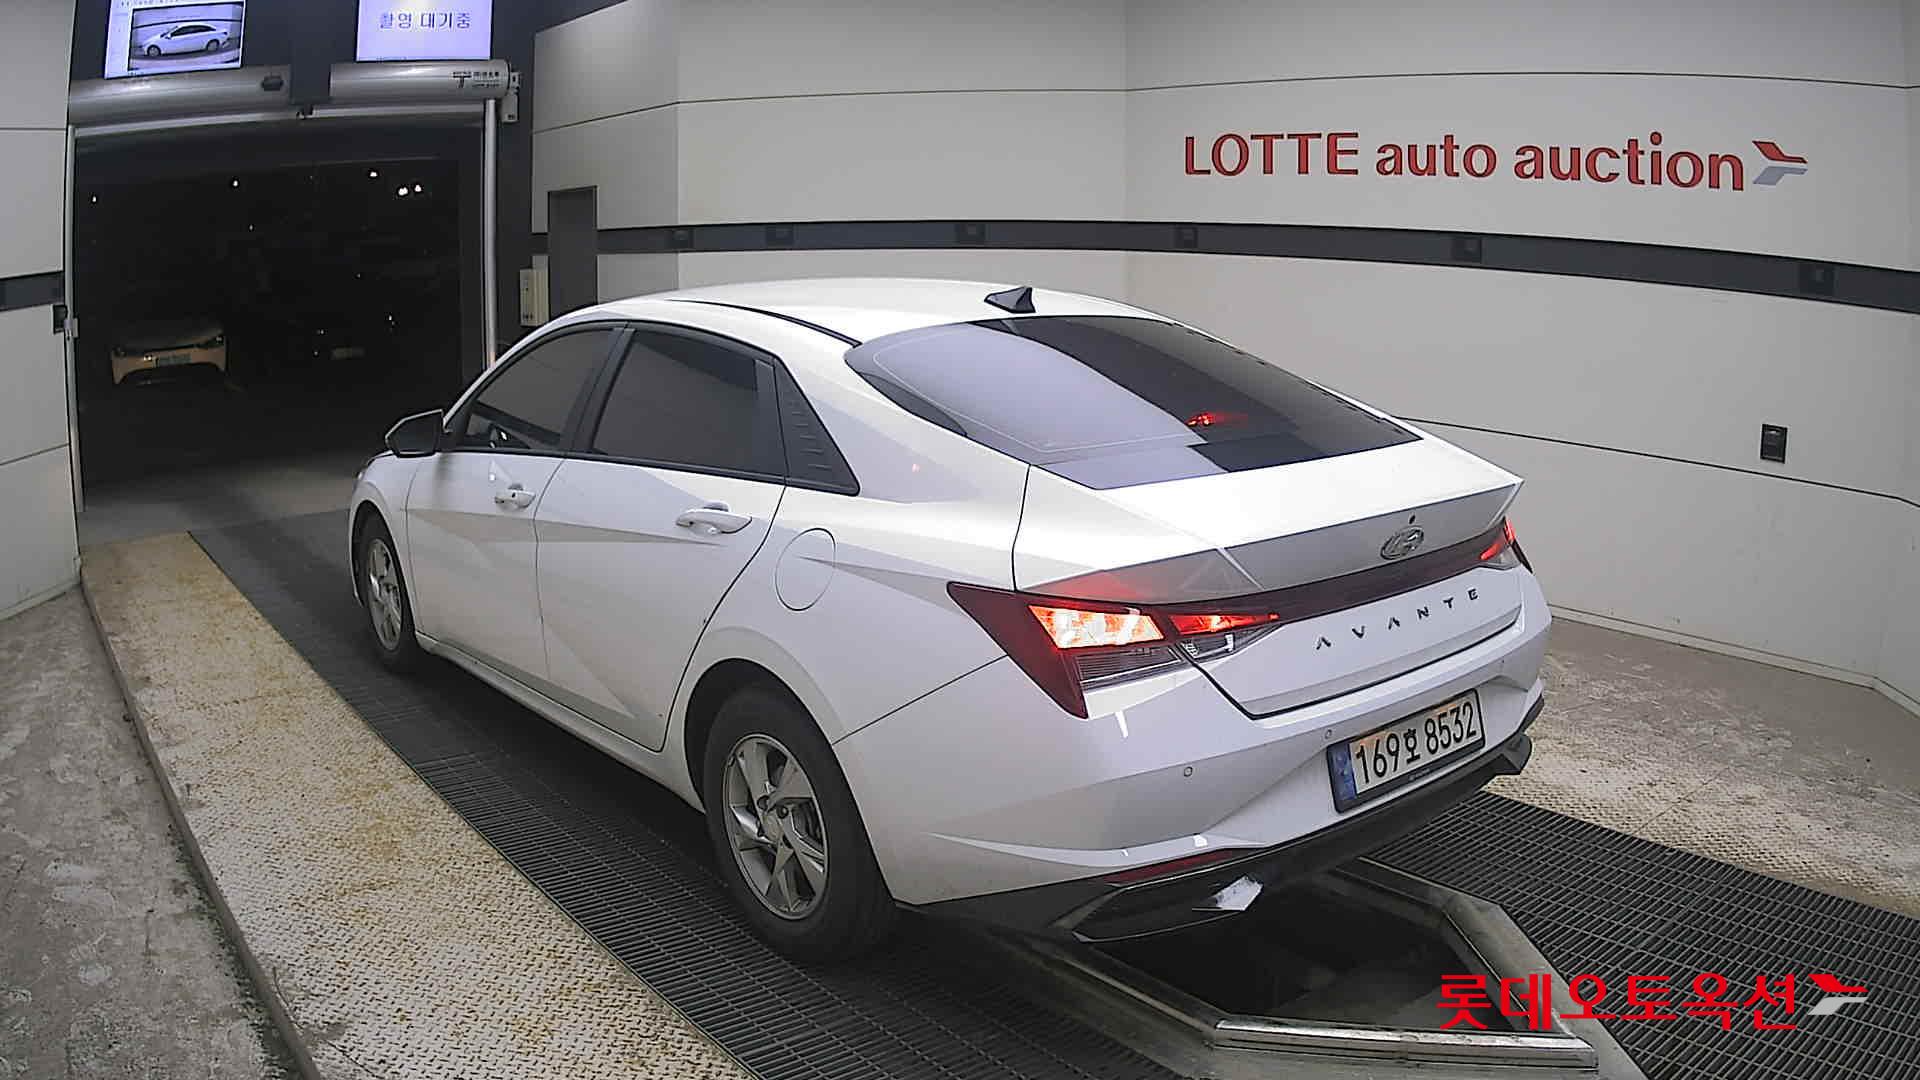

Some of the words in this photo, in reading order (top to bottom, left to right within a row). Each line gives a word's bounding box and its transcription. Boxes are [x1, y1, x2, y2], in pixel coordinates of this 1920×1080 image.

[420, 12, 471, 29] 대기중
[1184, 132, 1360, 177] LOTTE
[1375, 134, 1498, 178] auto
[1513, 130, 1745, 192] auction
[1314, 588, 1480, 651] AVANTE
[1354, 728, 1421, 785] 169호
[1424, 701, 1478, 755] 8532
